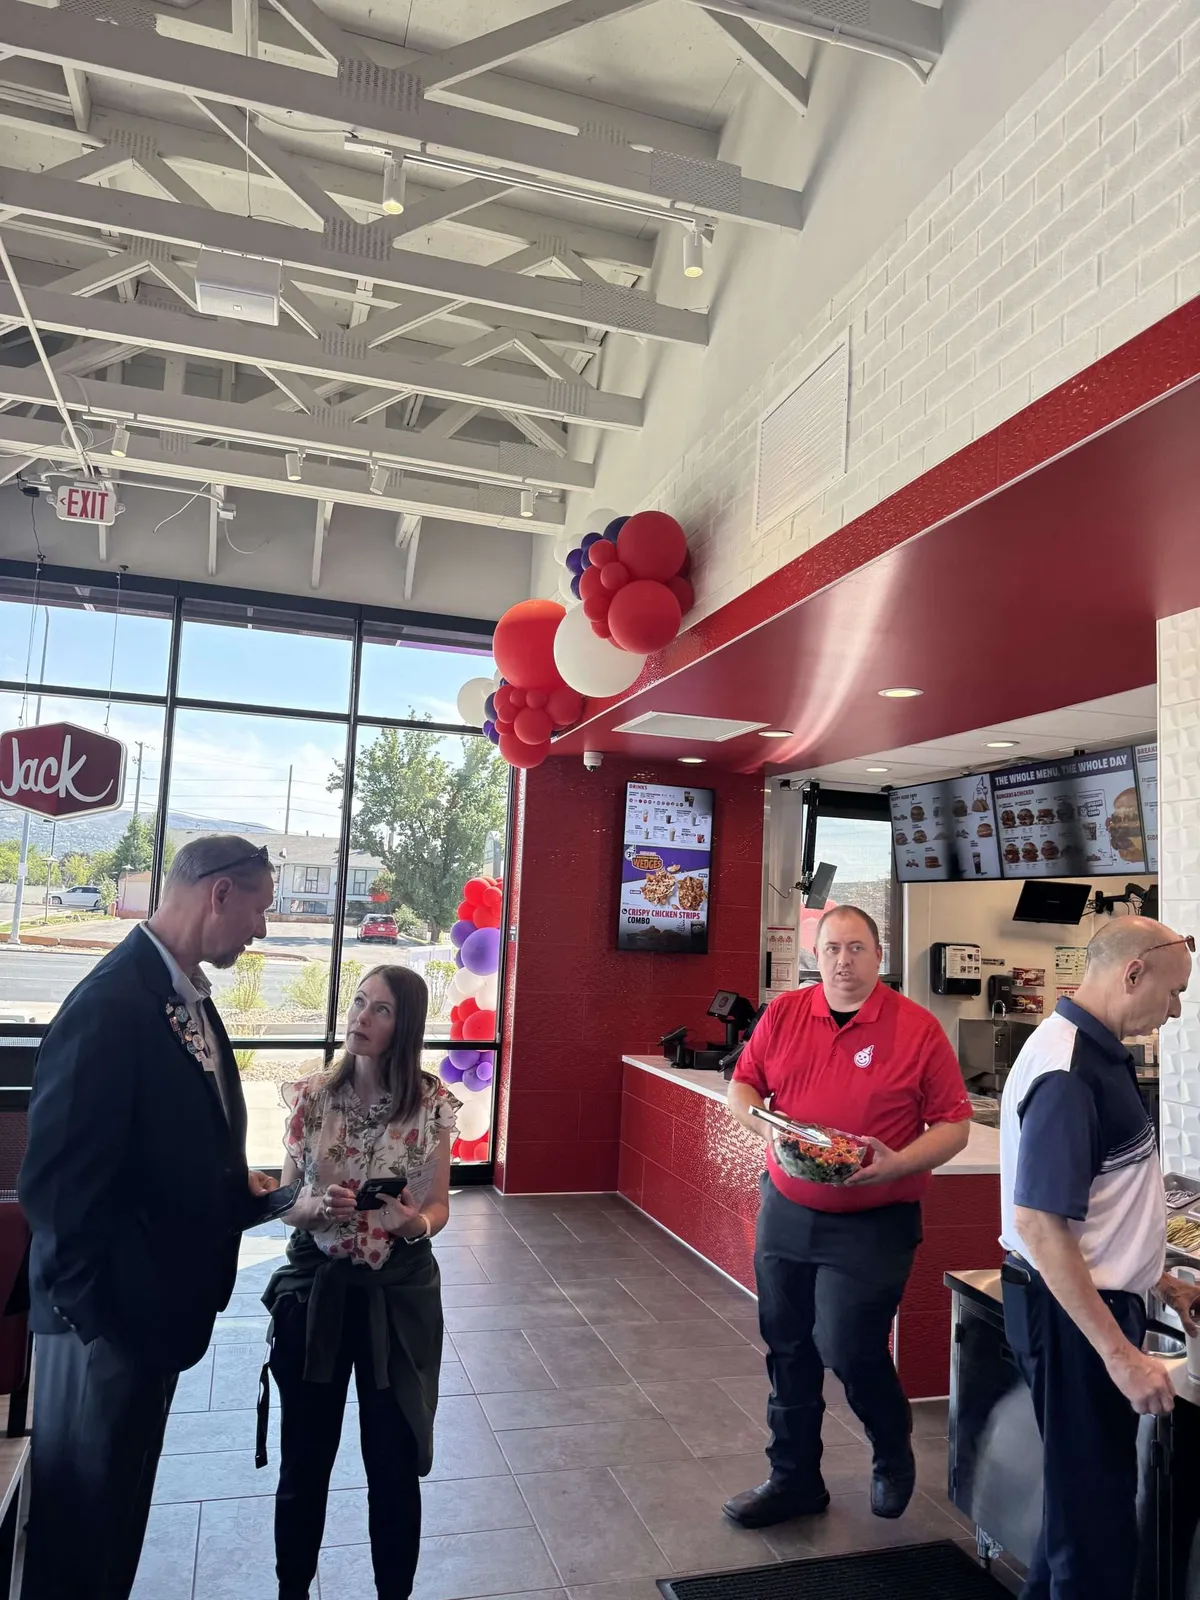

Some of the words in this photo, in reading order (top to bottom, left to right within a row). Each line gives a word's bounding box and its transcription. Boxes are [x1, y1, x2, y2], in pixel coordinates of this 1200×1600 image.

[67, 488, 109, 520] EXIT
[0, 734, 114, 803] Jack
[995, 776, 1009, 786] THE
[1009, 771, 1035, 784] WHOLE
[1061, 763, 1077, 775] THE
[1077, 758, 1109, 772] WHOLE
[1109, 755, 1128, 767] DAY
[628, 783, 648, 791] DRINKS
[633, 857, 662, 869] WEDGES
[628, 908, 650, 917] CRISPY
[651, 909, 678, 919] CHICKEN
[678, 911, 701, 920] STRIPS
[627, 916, 651, 925] COMBO
